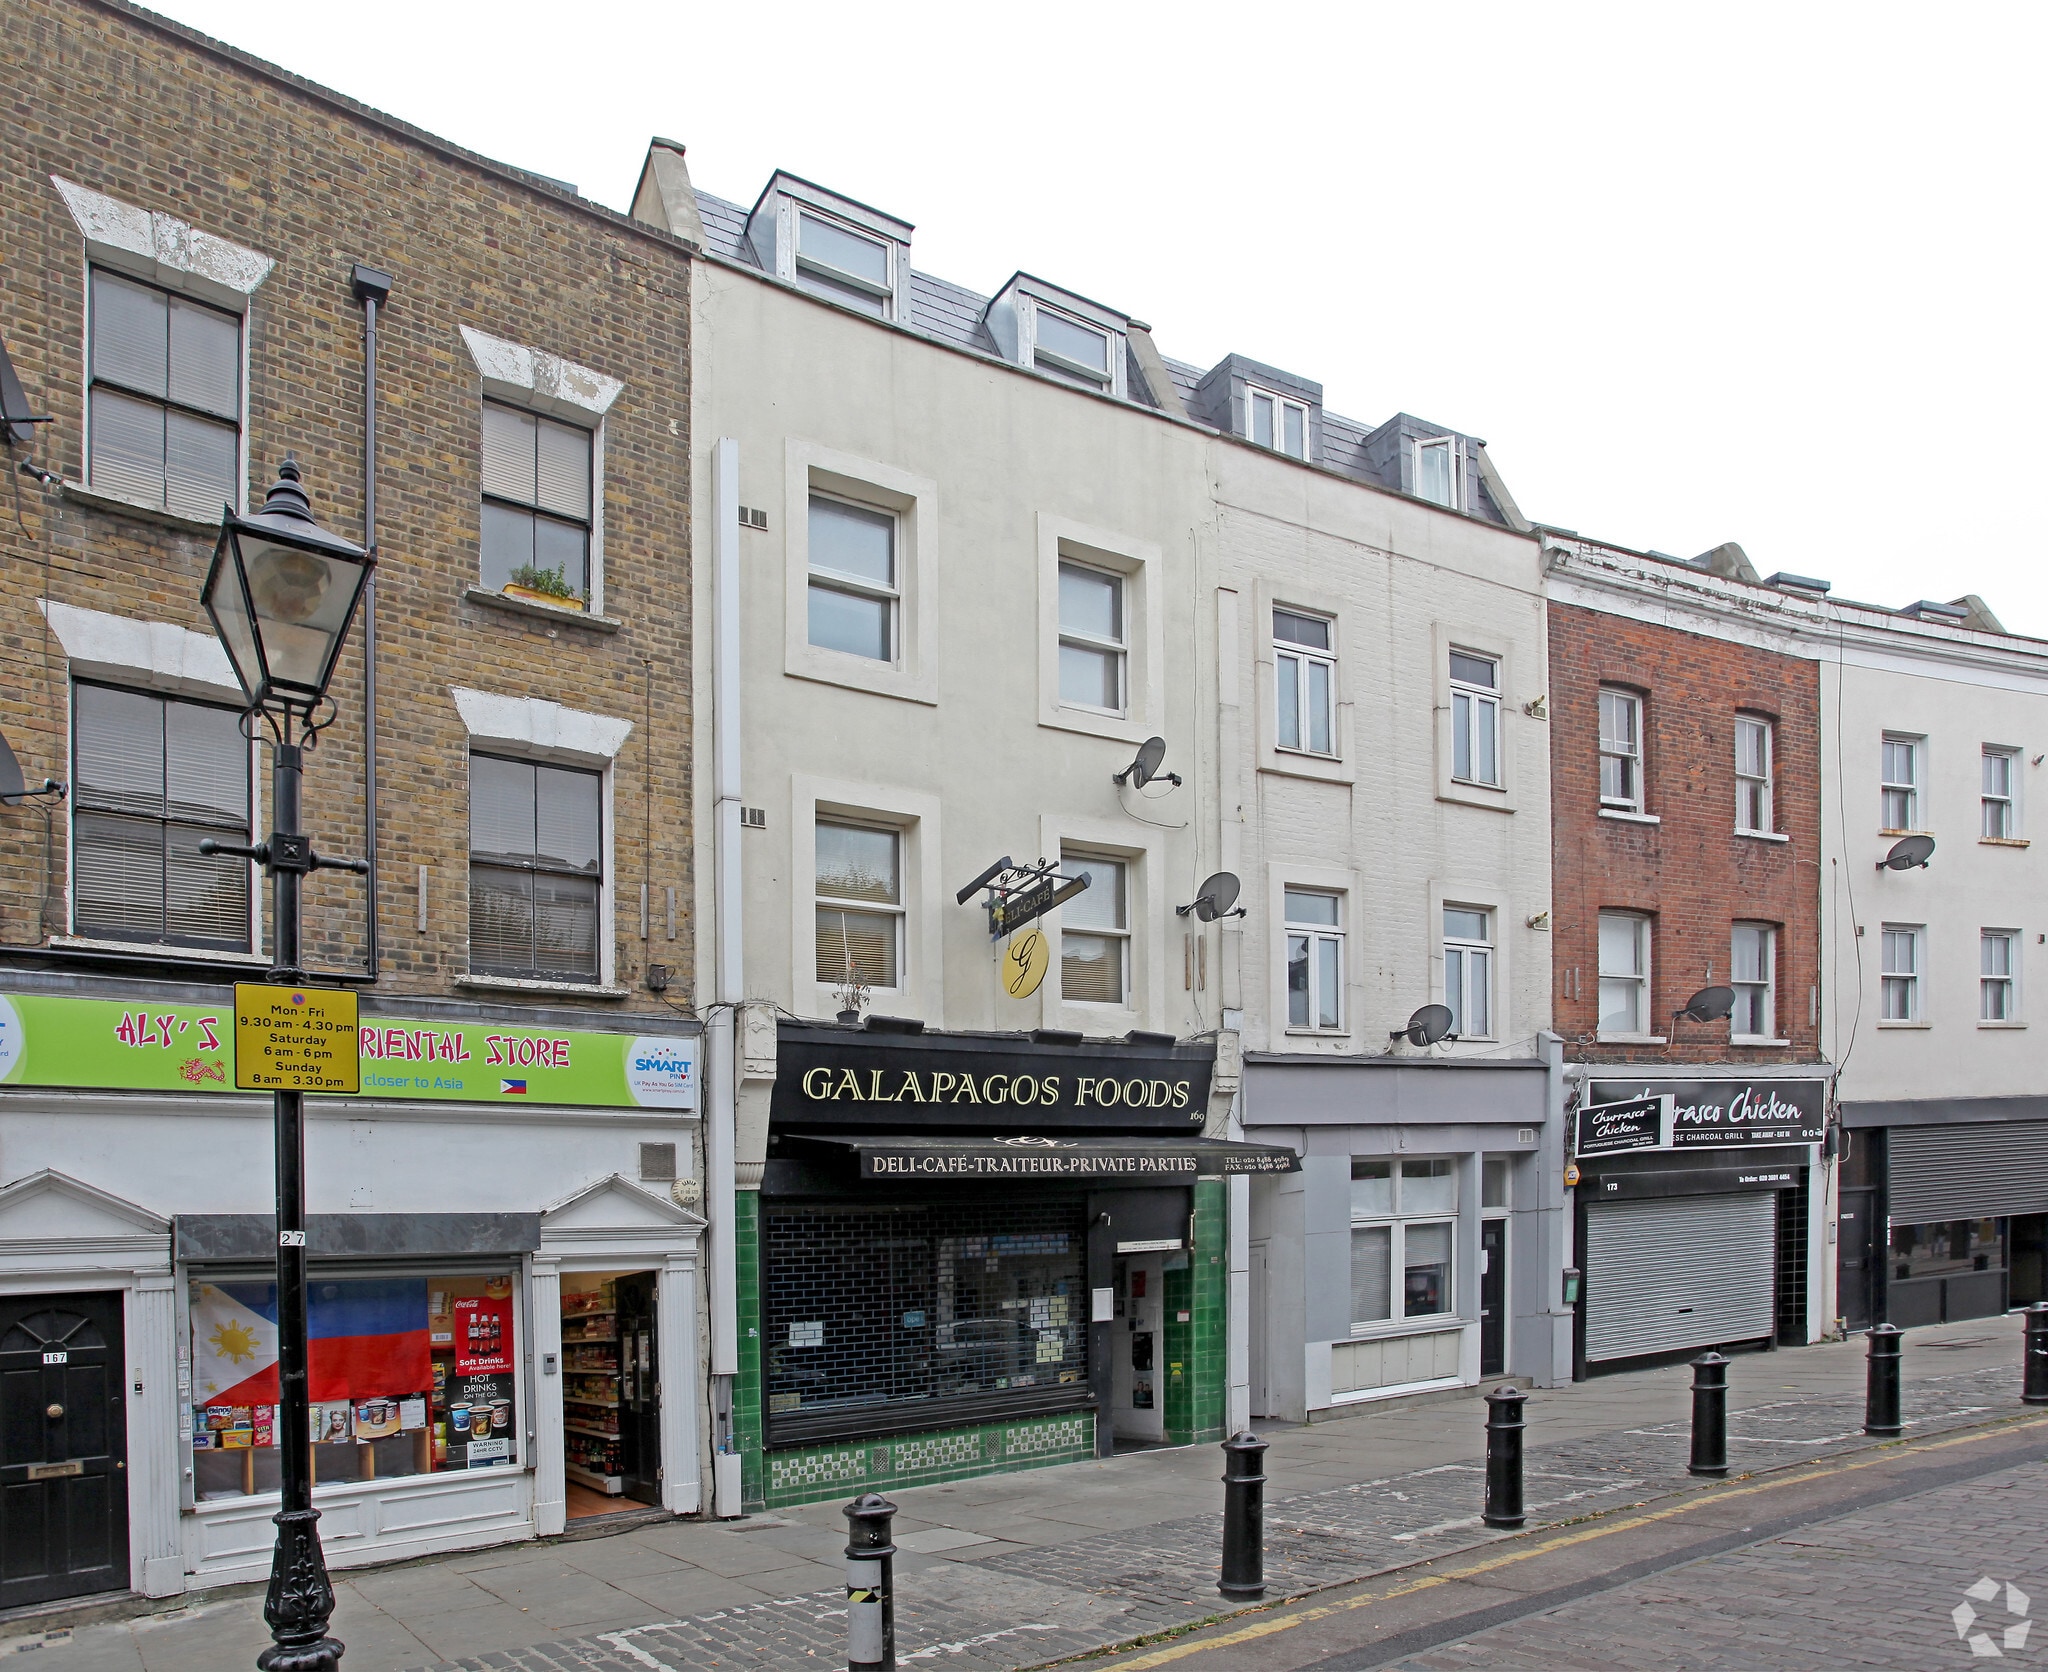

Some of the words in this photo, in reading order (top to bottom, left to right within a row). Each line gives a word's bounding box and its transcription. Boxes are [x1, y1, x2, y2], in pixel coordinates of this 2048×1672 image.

[1005, 886, 1050, 923] ELI-CAFÉ
[271, 1005, 298, 1016] Mon
[308, 1008, 325, 1017] Fri
[240, 1016, 271, 1027] 9.30
[274, 1020, 293, 1028] am
[302, 1020, 333, 1031] 4.30
[336, 1024, 354, 1032] pm
[115, 1012, 220, 1050] ALY'S
[269, 1033, 327, 1046] Saturday
[264, 1046, 272, 1056] 6
[303, 1048, 311, 1058] 6
[314, 1050, 333, 1059] pm
[360, 1027, 470, 1063] RIENTAL
[485, 1035, 570, 1068] STORE
[275, 1061, 322, 1074] Sunday
[635, 1058, 692, 1073] SMART
[252, 1074, 261, 1083] 8
[263, 1076, 282, 1084] am
[293, 1075, 323, 1085] 3.30
[326, 1079, 344, 1087] pm
[364, 1073, 410, 1088] closer
[414, 1076, 429, 1088] to
[433, 1076, 463, 1089] Asia
[802, 1067, 1060, 1105] GALAPAGOS
[1074, 1077, 1190, 1108] FOODS
[1728, 1087, 1802, 1123] Chicken
[1190, 1110, 1205, 1122] 169
[1592, 1109, 1647, 1124] Churrasco
[1596, 1122, 1640, 1137] Chicken
[1583, 1140, 1614, 1149] PORTUGUESE
[1614, 1137, 1639, 1145] CHARCOAL
[1686, 1133, 1723, 1141] CHARCOAL
[1724, 1132, 1744, 1140] GRILL
[1139, 1157, 1197, 1171] PARTIES
[1607, 1183, 1618, 1191] 173
[45, 1353, 66, 1363] 167
[478, 1357, 504, 1365] Drinks
[470, 1374, 490, 1383] HOT
[463, 1383, 497, 1393] DRINKS
[472, 1440, 503, 1448] WARNING
